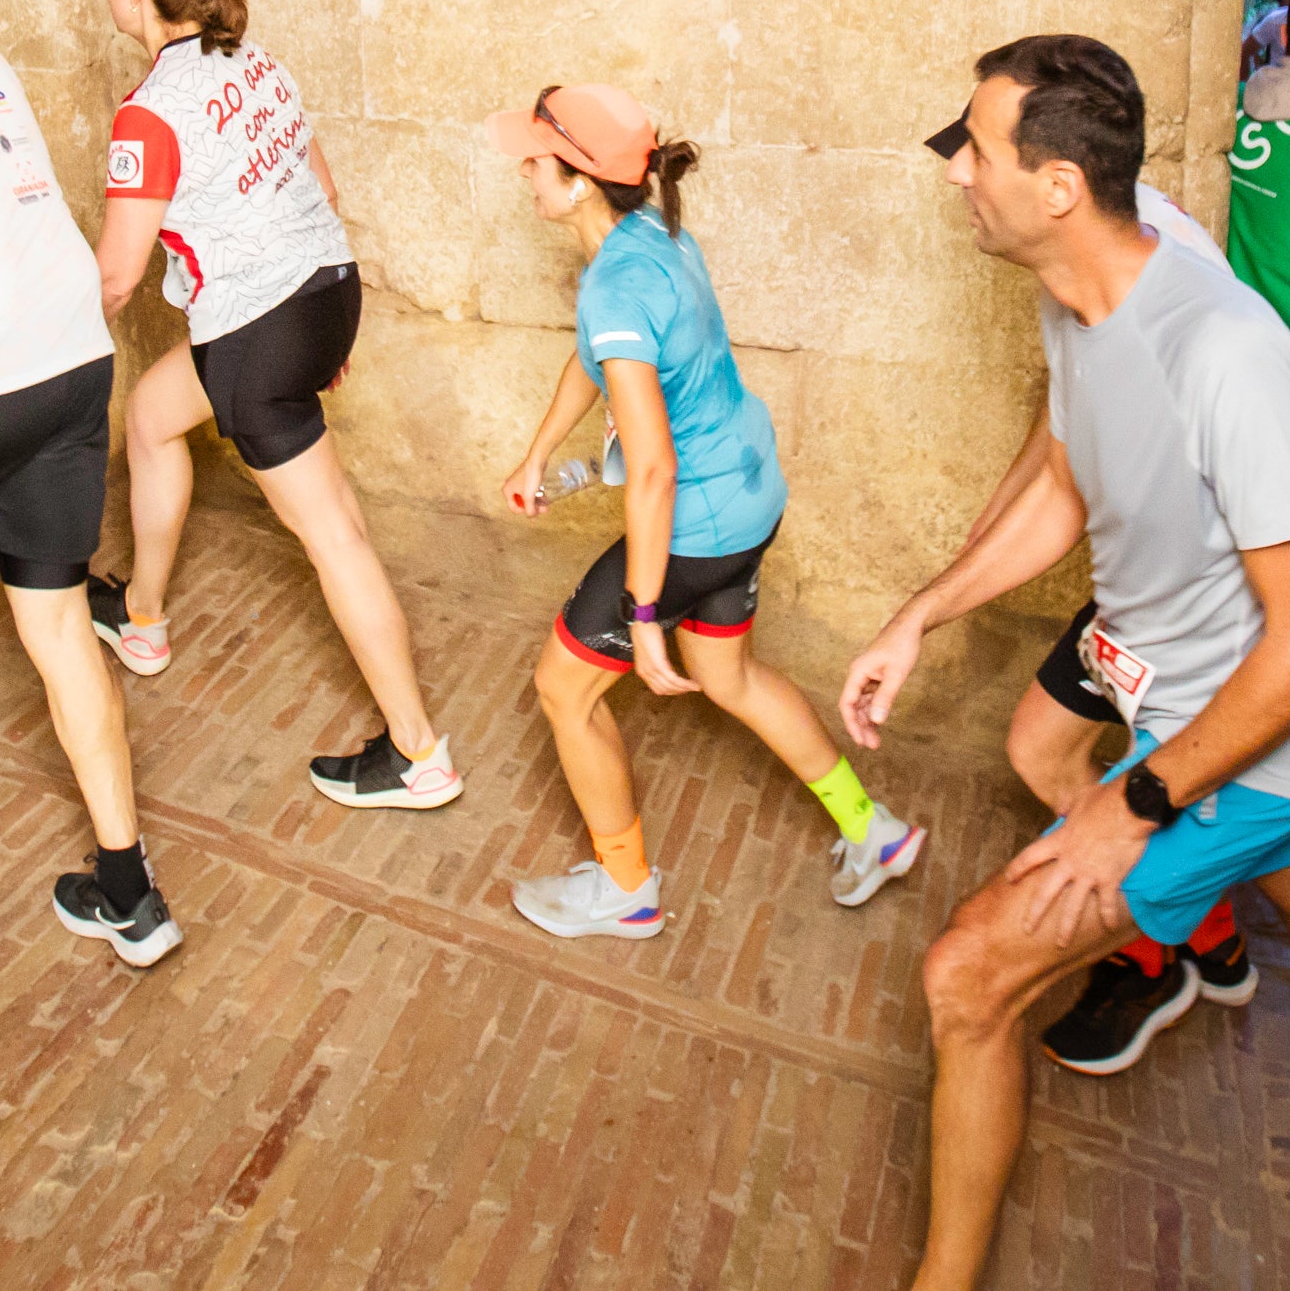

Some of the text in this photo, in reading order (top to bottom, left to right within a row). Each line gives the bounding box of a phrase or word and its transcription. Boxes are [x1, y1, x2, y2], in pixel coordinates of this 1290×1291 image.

[207, 82, 243, 135] 20
[245, 76, 292, 142] con el
